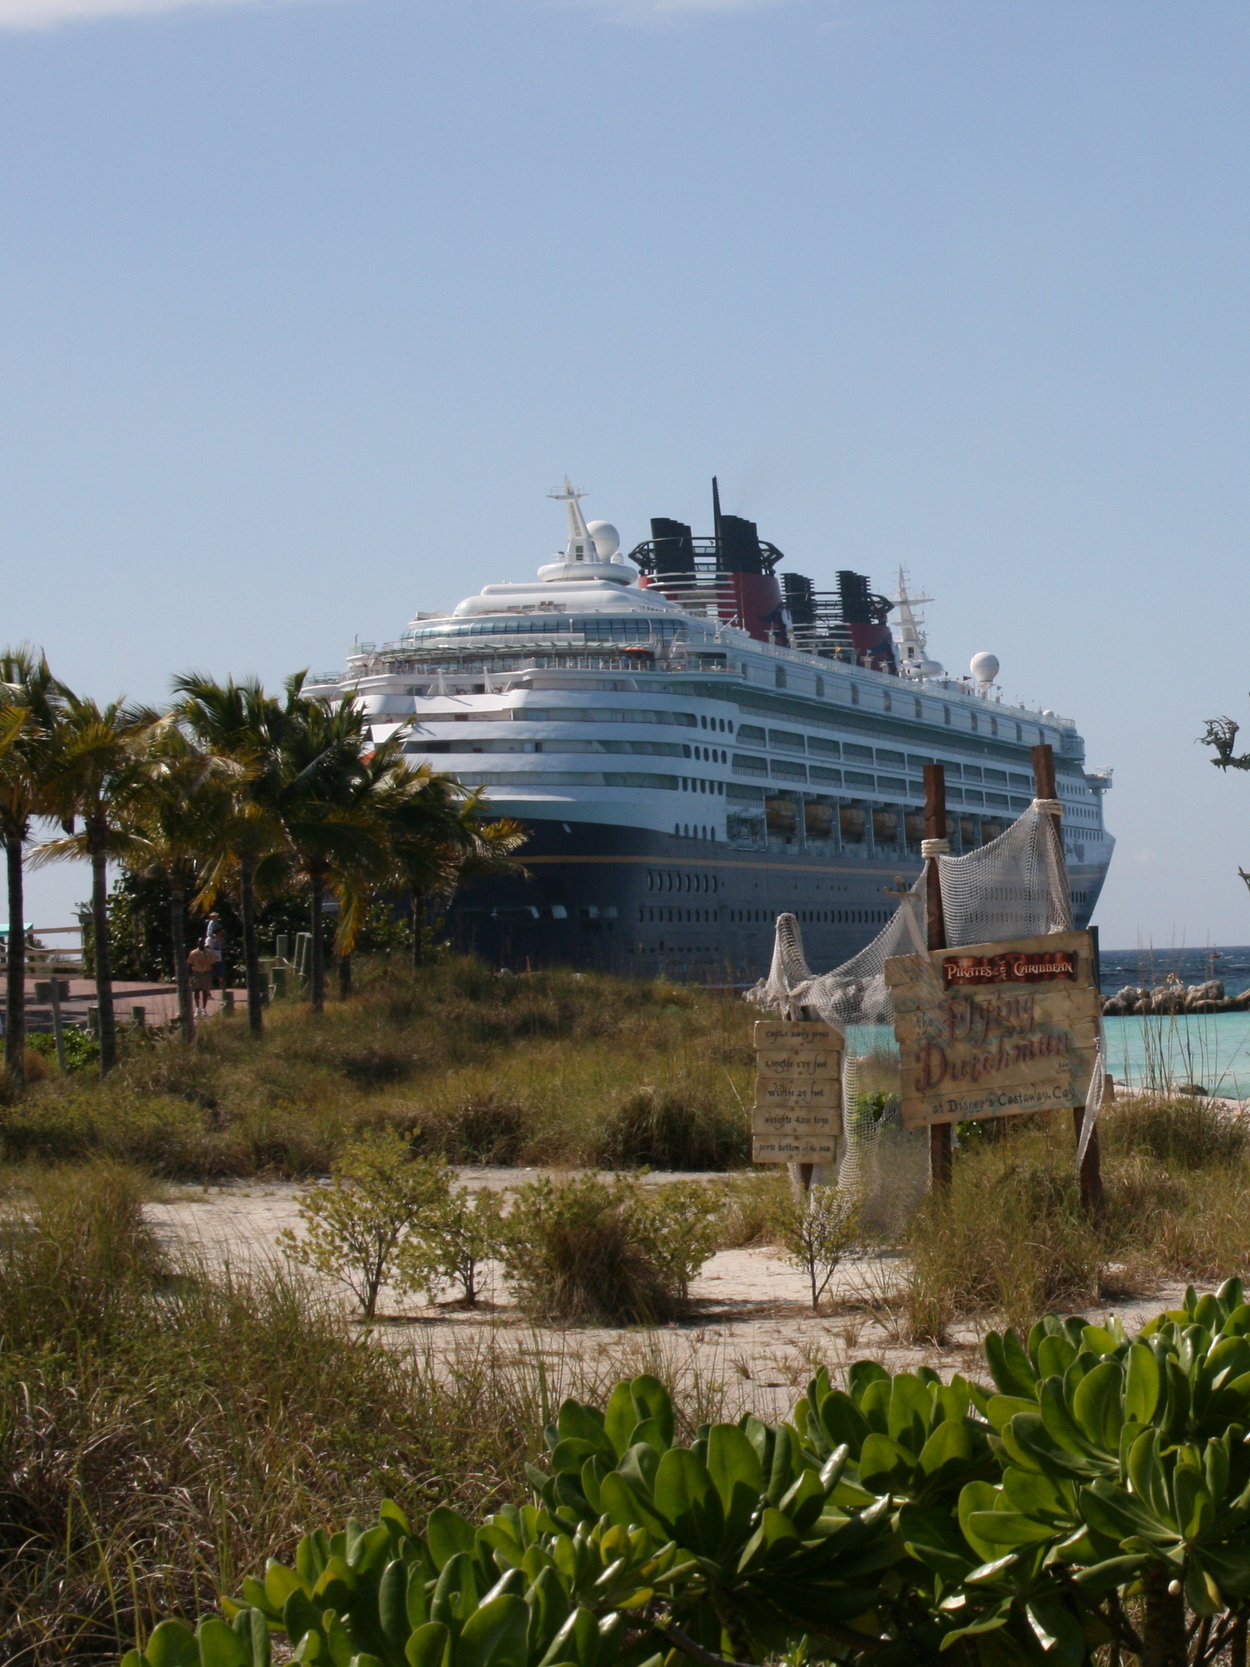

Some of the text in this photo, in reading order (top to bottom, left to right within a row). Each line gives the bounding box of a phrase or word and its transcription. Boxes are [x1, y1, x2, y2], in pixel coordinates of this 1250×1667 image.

[938, 992, 1035, 1049] Flying
[809, 1052, 827, 1076] feet
[915, 1031, 1070, 1092] Dutchman
[797, 1090, 806, 1101] 25
[805, 1081, 824, 1104] feet
[932, 1101, 944, 1114] at
[948, 1096, 994, 1115] Disney's
[1053, 1086, 1077, 1102] Cay
[795, 1116, 811, 1124] 420
[813, 1115, 829, 1128] tons
